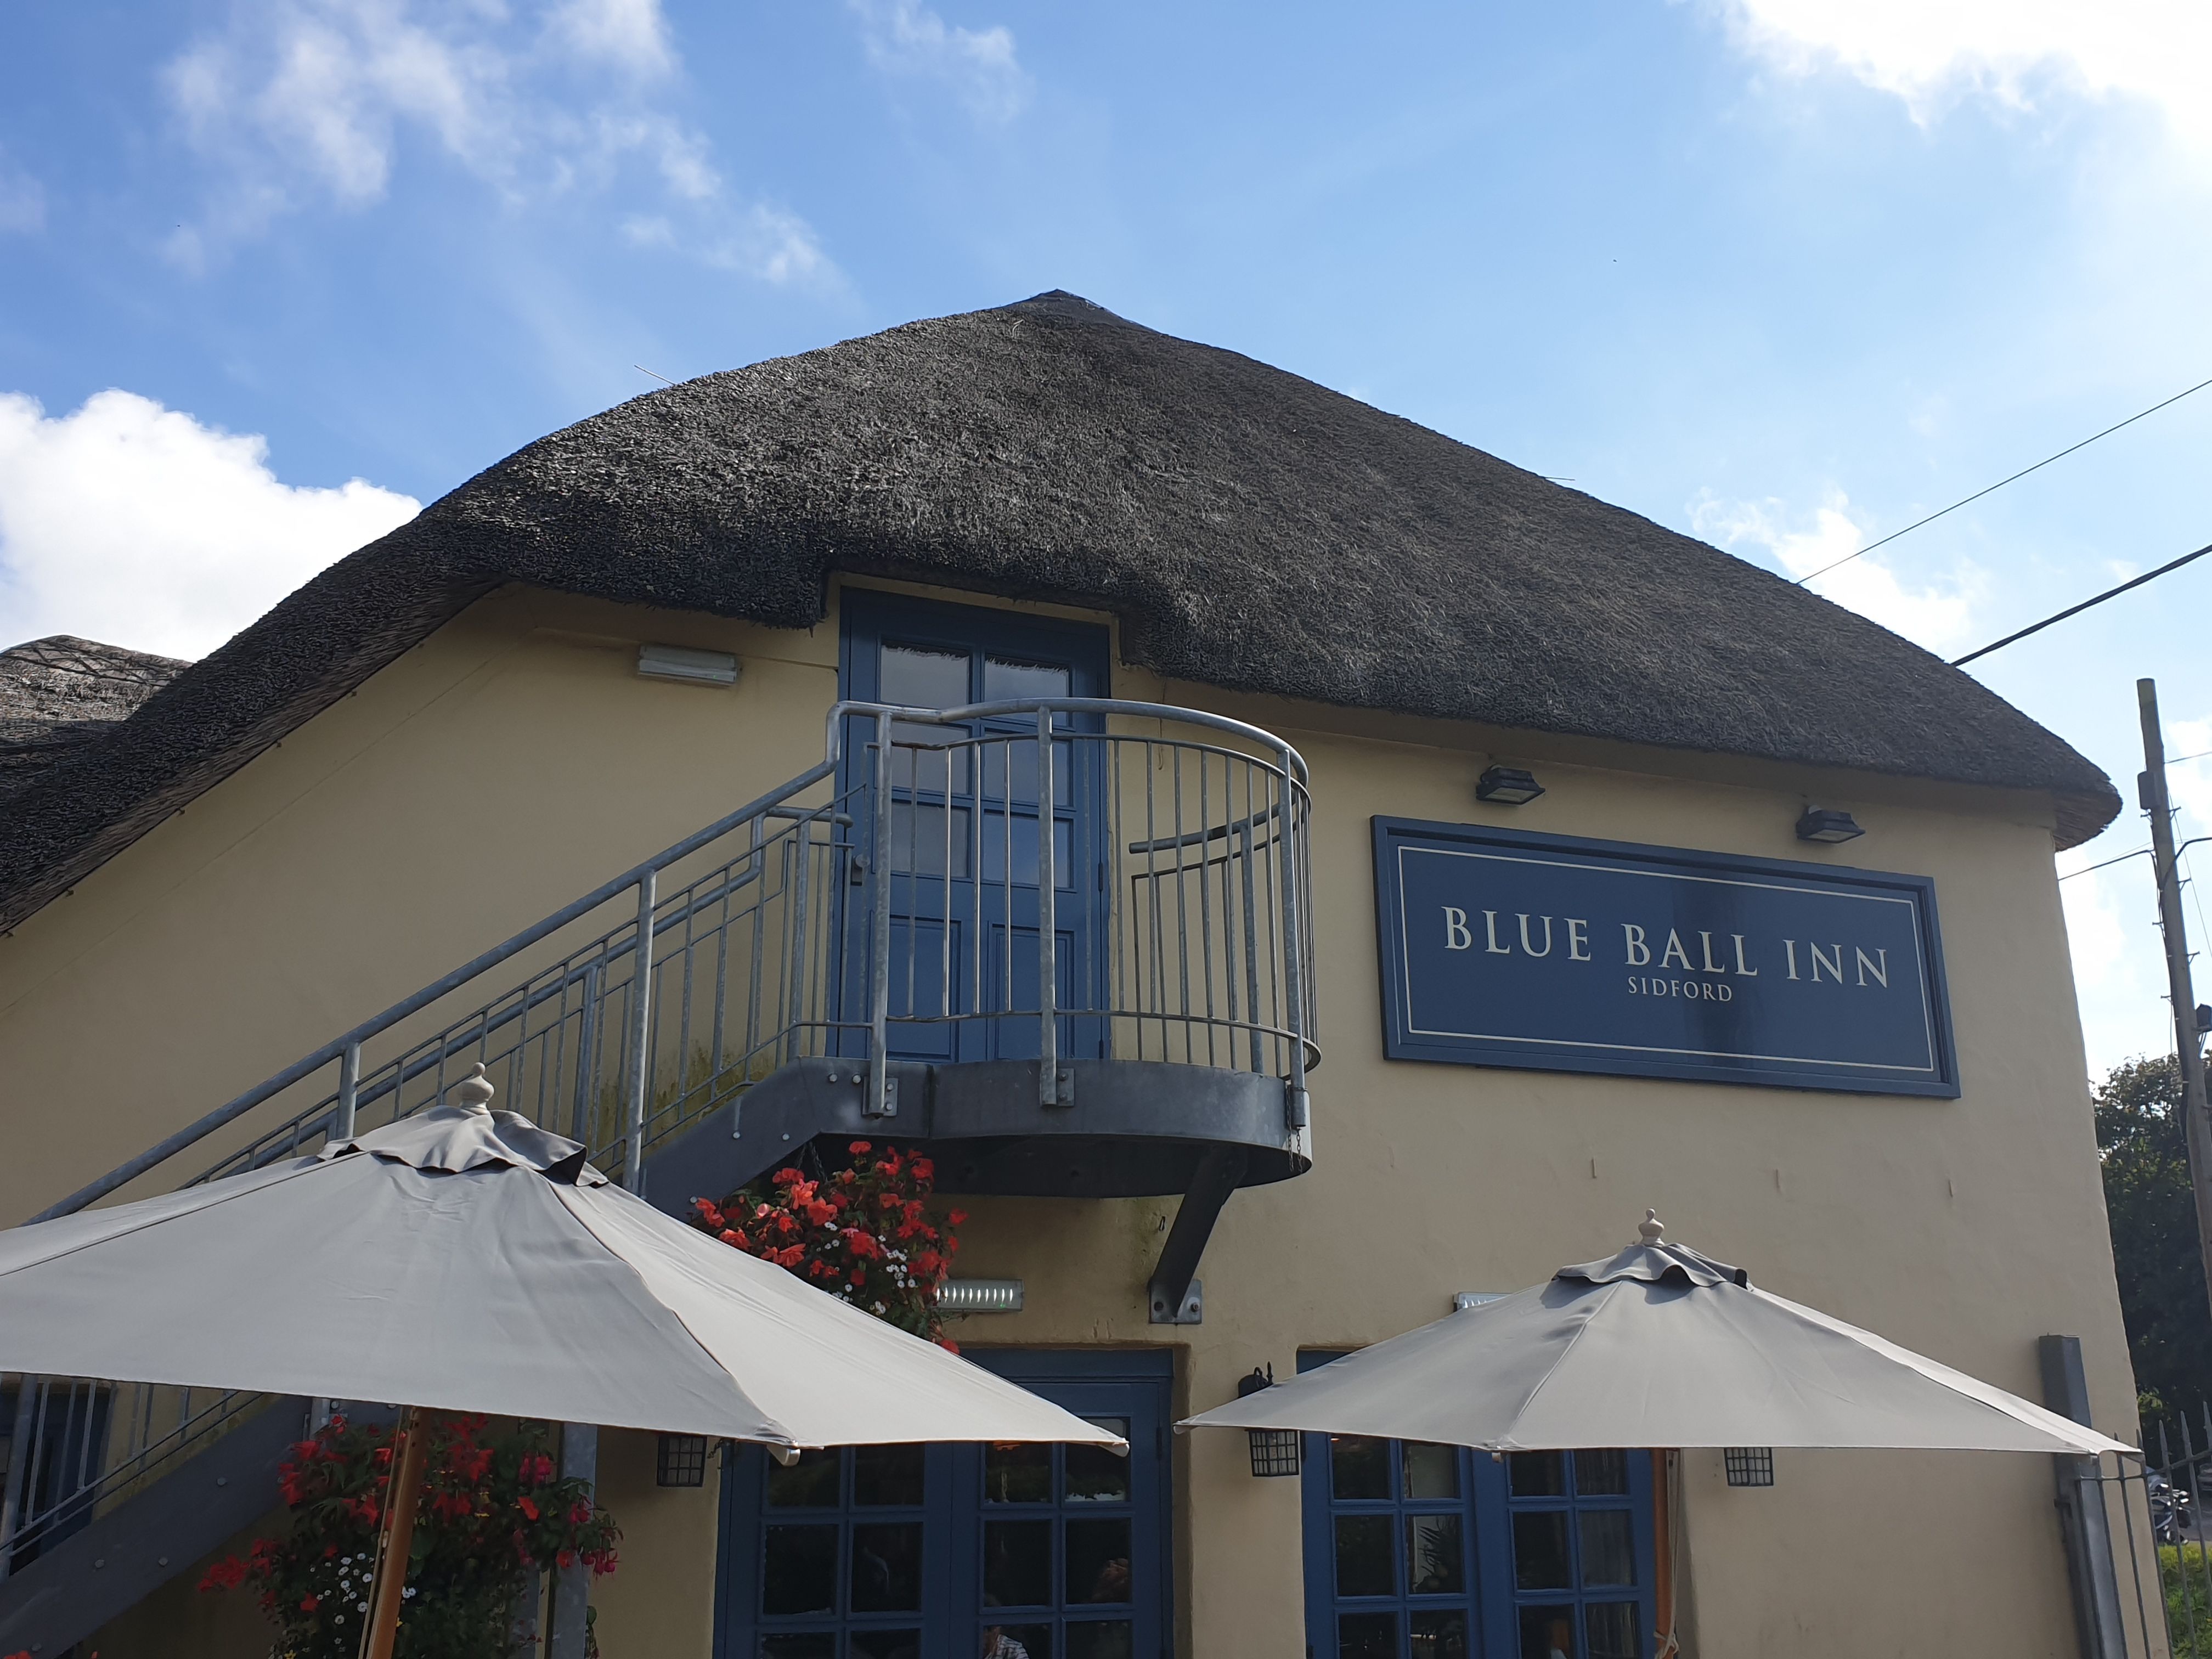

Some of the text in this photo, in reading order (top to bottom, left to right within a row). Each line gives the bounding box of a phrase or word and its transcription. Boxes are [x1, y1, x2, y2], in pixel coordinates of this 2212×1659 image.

[1441, 906, 1888, 989] BLUE BALL INN
[1628, 976, 1733, 1002] SIDFORD
